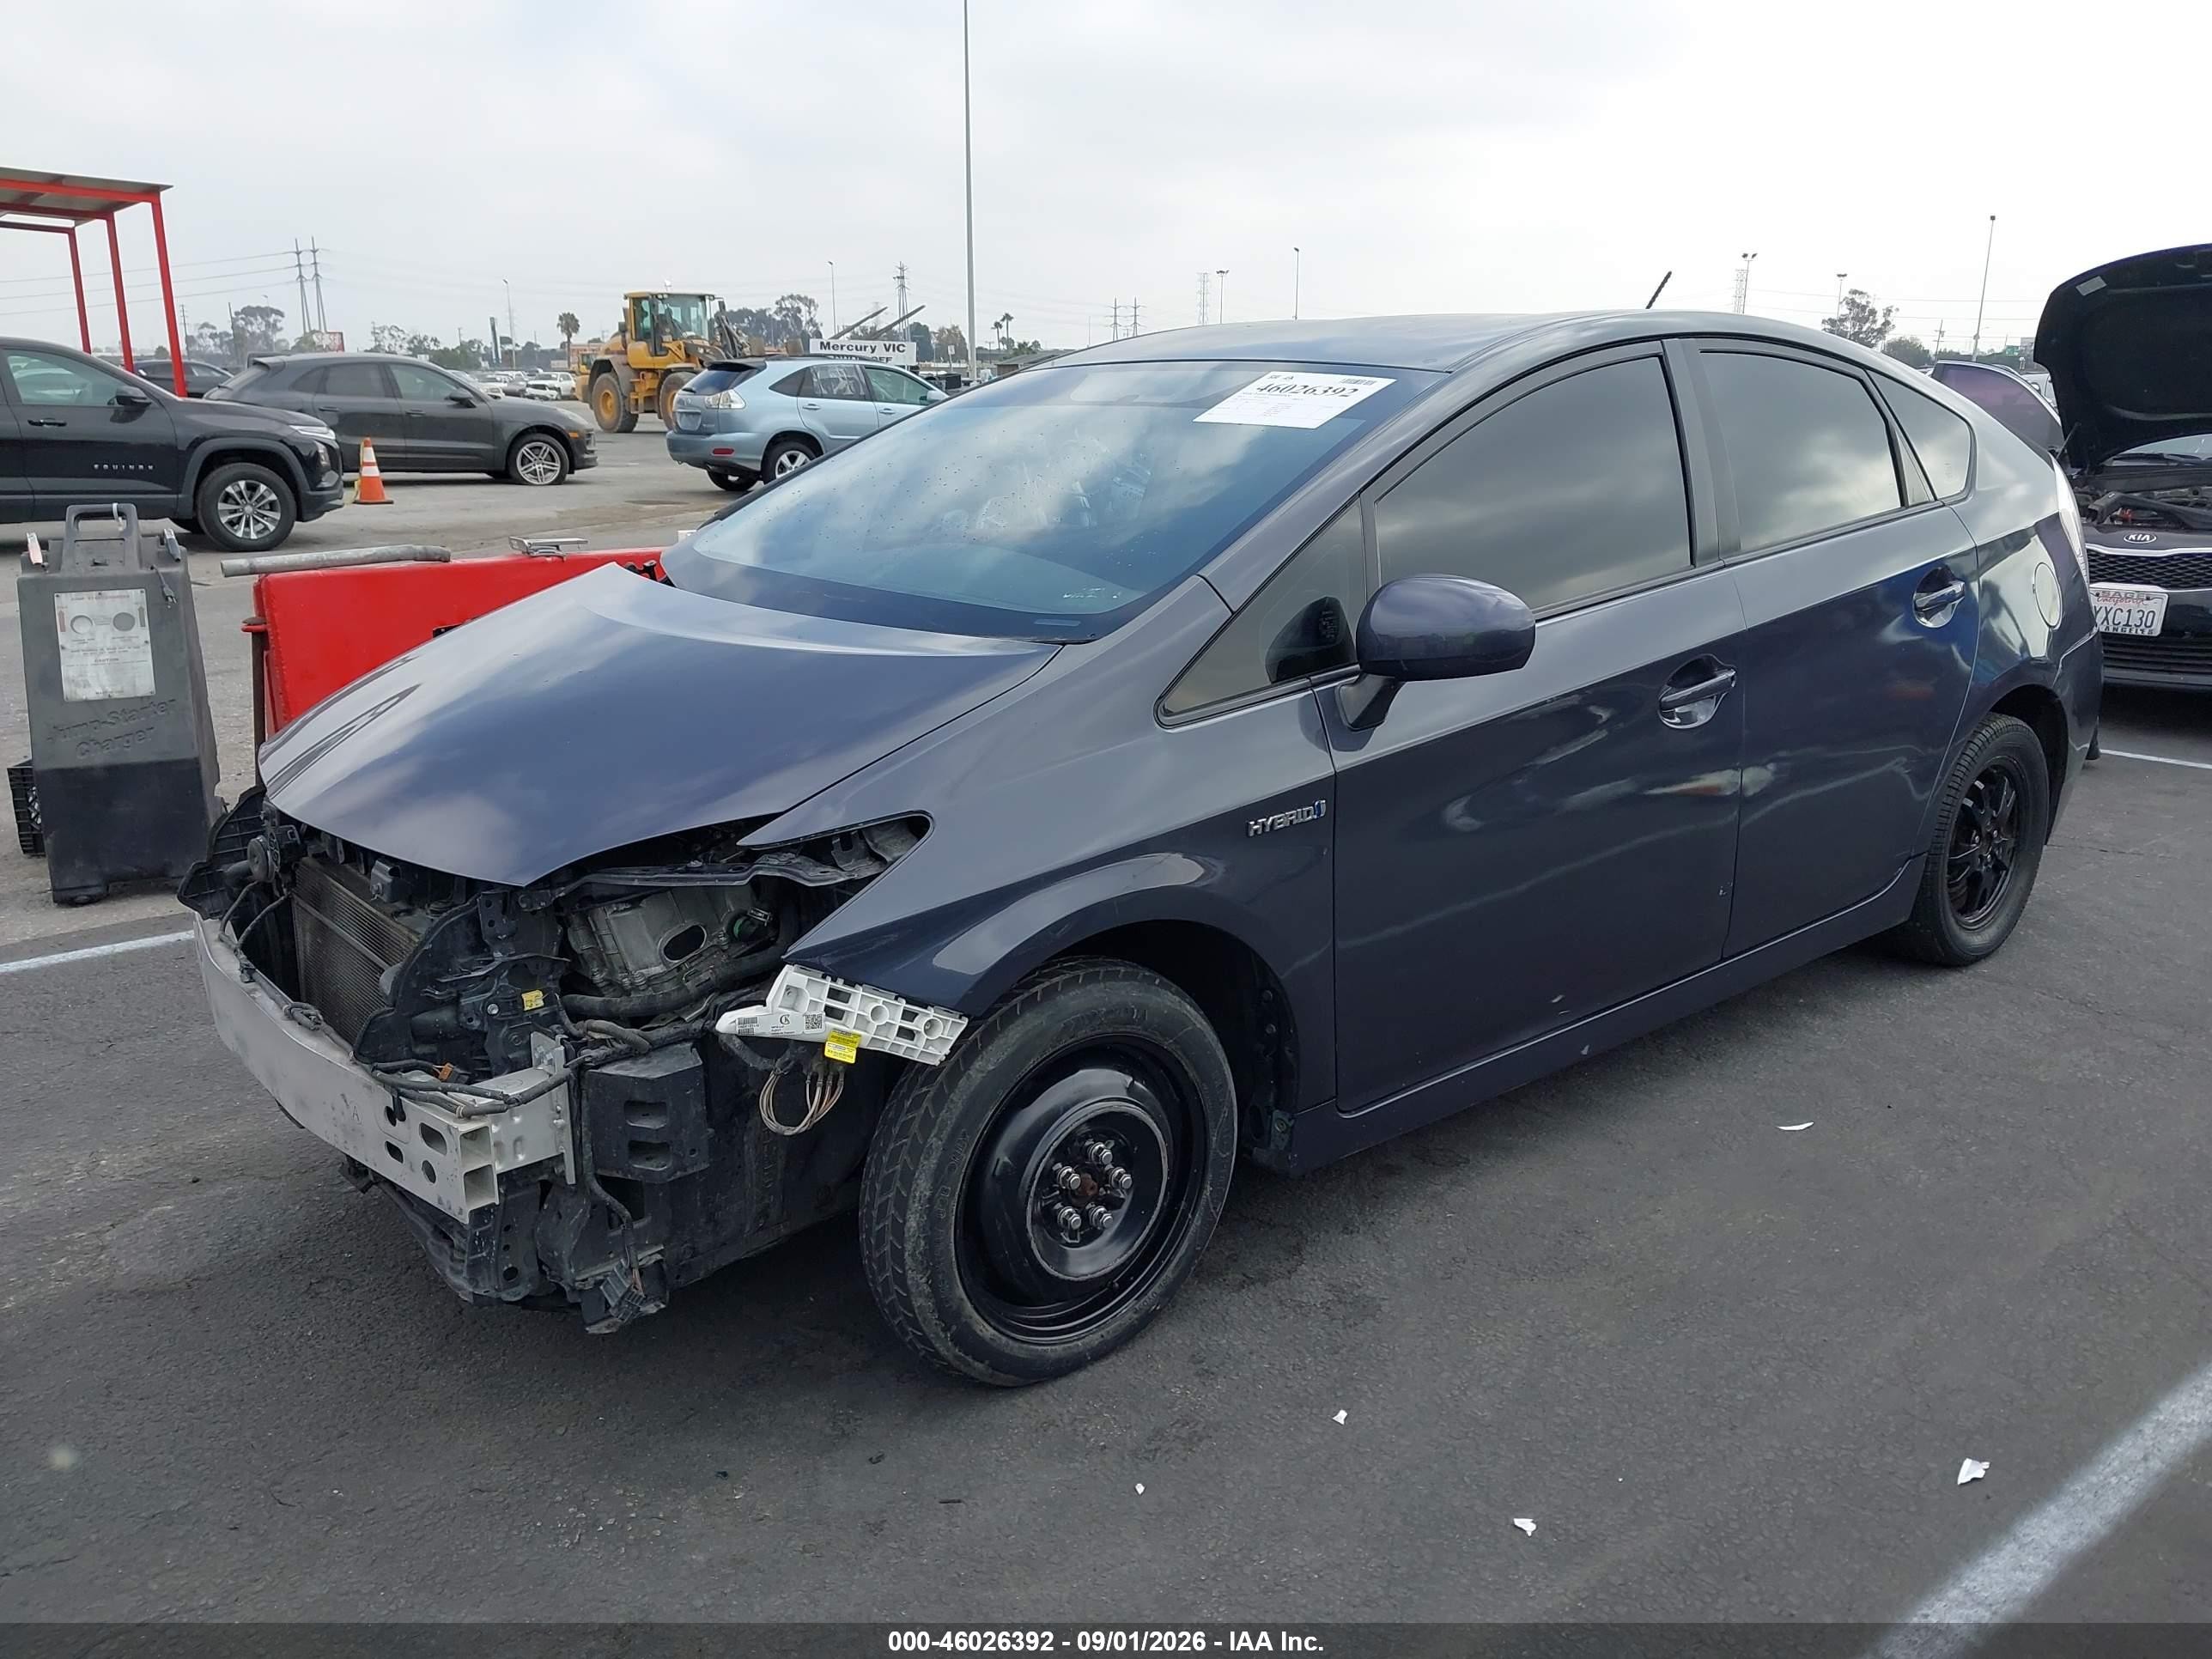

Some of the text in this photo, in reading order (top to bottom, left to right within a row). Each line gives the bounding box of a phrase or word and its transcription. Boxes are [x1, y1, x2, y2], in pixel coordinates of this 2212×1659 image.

[819, 341, 906, 354] Mercury VIC
[1256, 383, 1358, 398] 46026392
[76, 726, 155, 759] Charger
[1248, 805, 1315, 837] HYBRID
